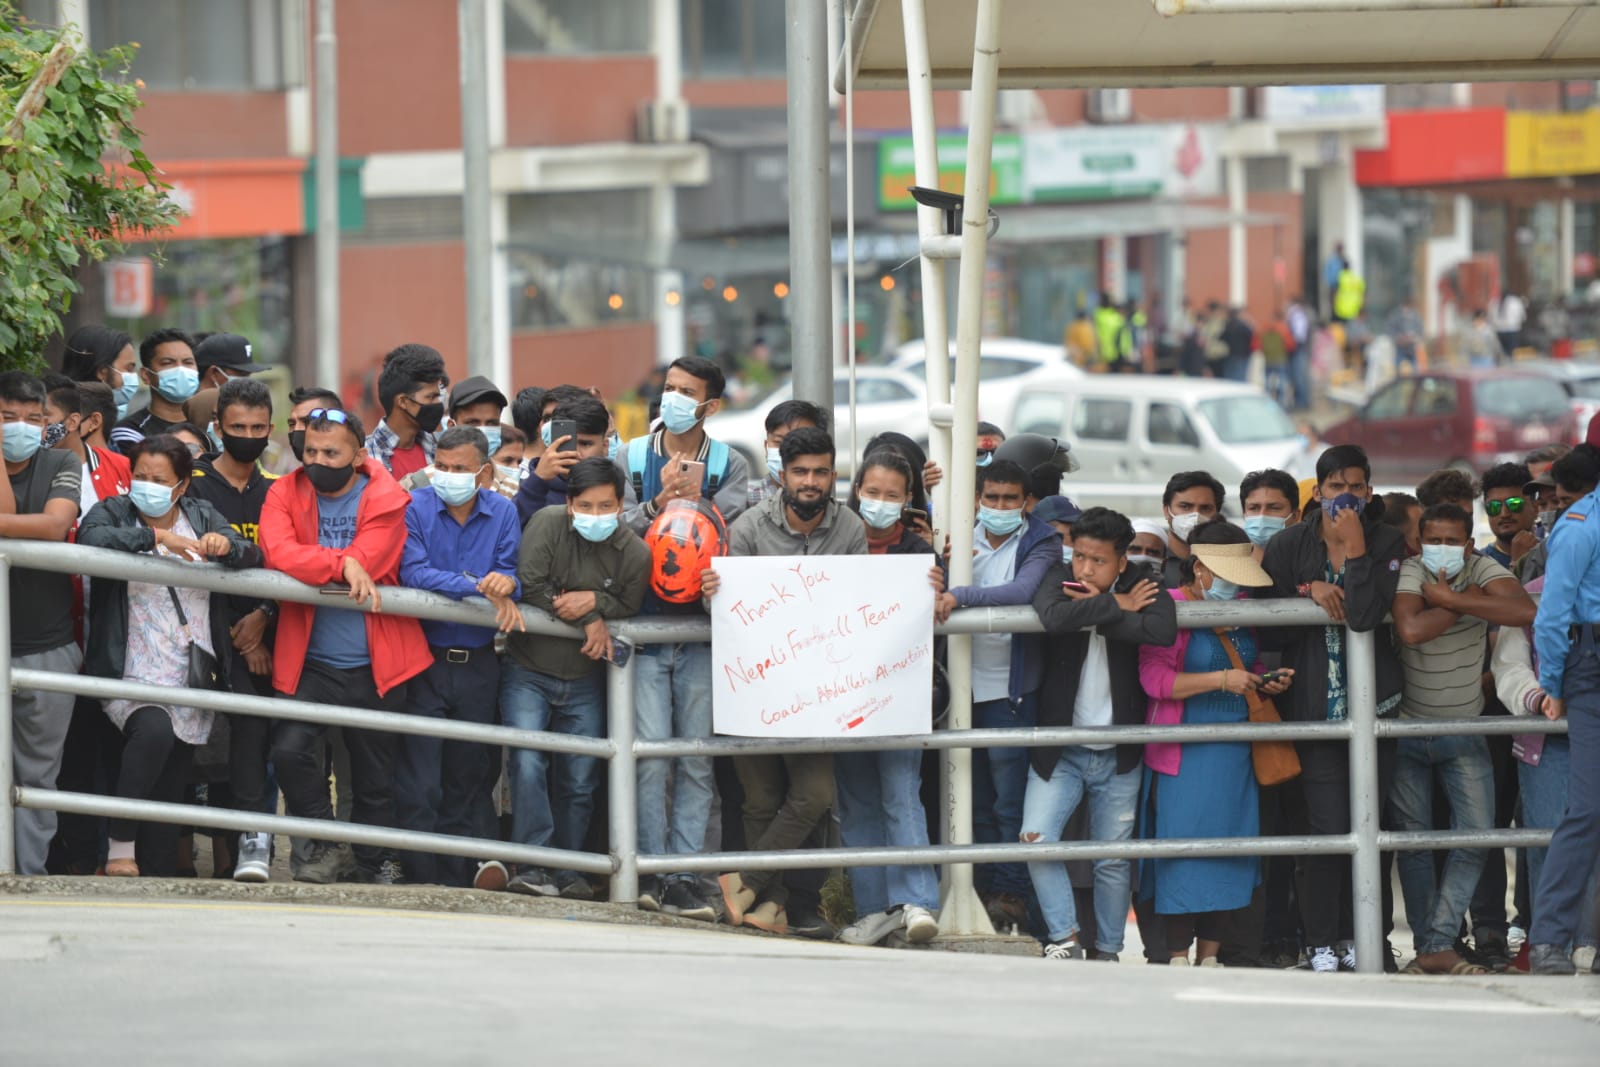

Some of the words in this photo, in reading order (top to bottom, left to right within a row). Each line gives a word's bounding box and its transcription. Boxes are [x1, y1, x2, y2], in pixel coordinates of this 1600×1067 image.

[731, 583, 796, 626] Thank
[788, 563, 831, 602] You
[723, 643, 787, 693] Nepali
[857, 602, 901, 629] Team
[761, 692, 813, 725] Coach
